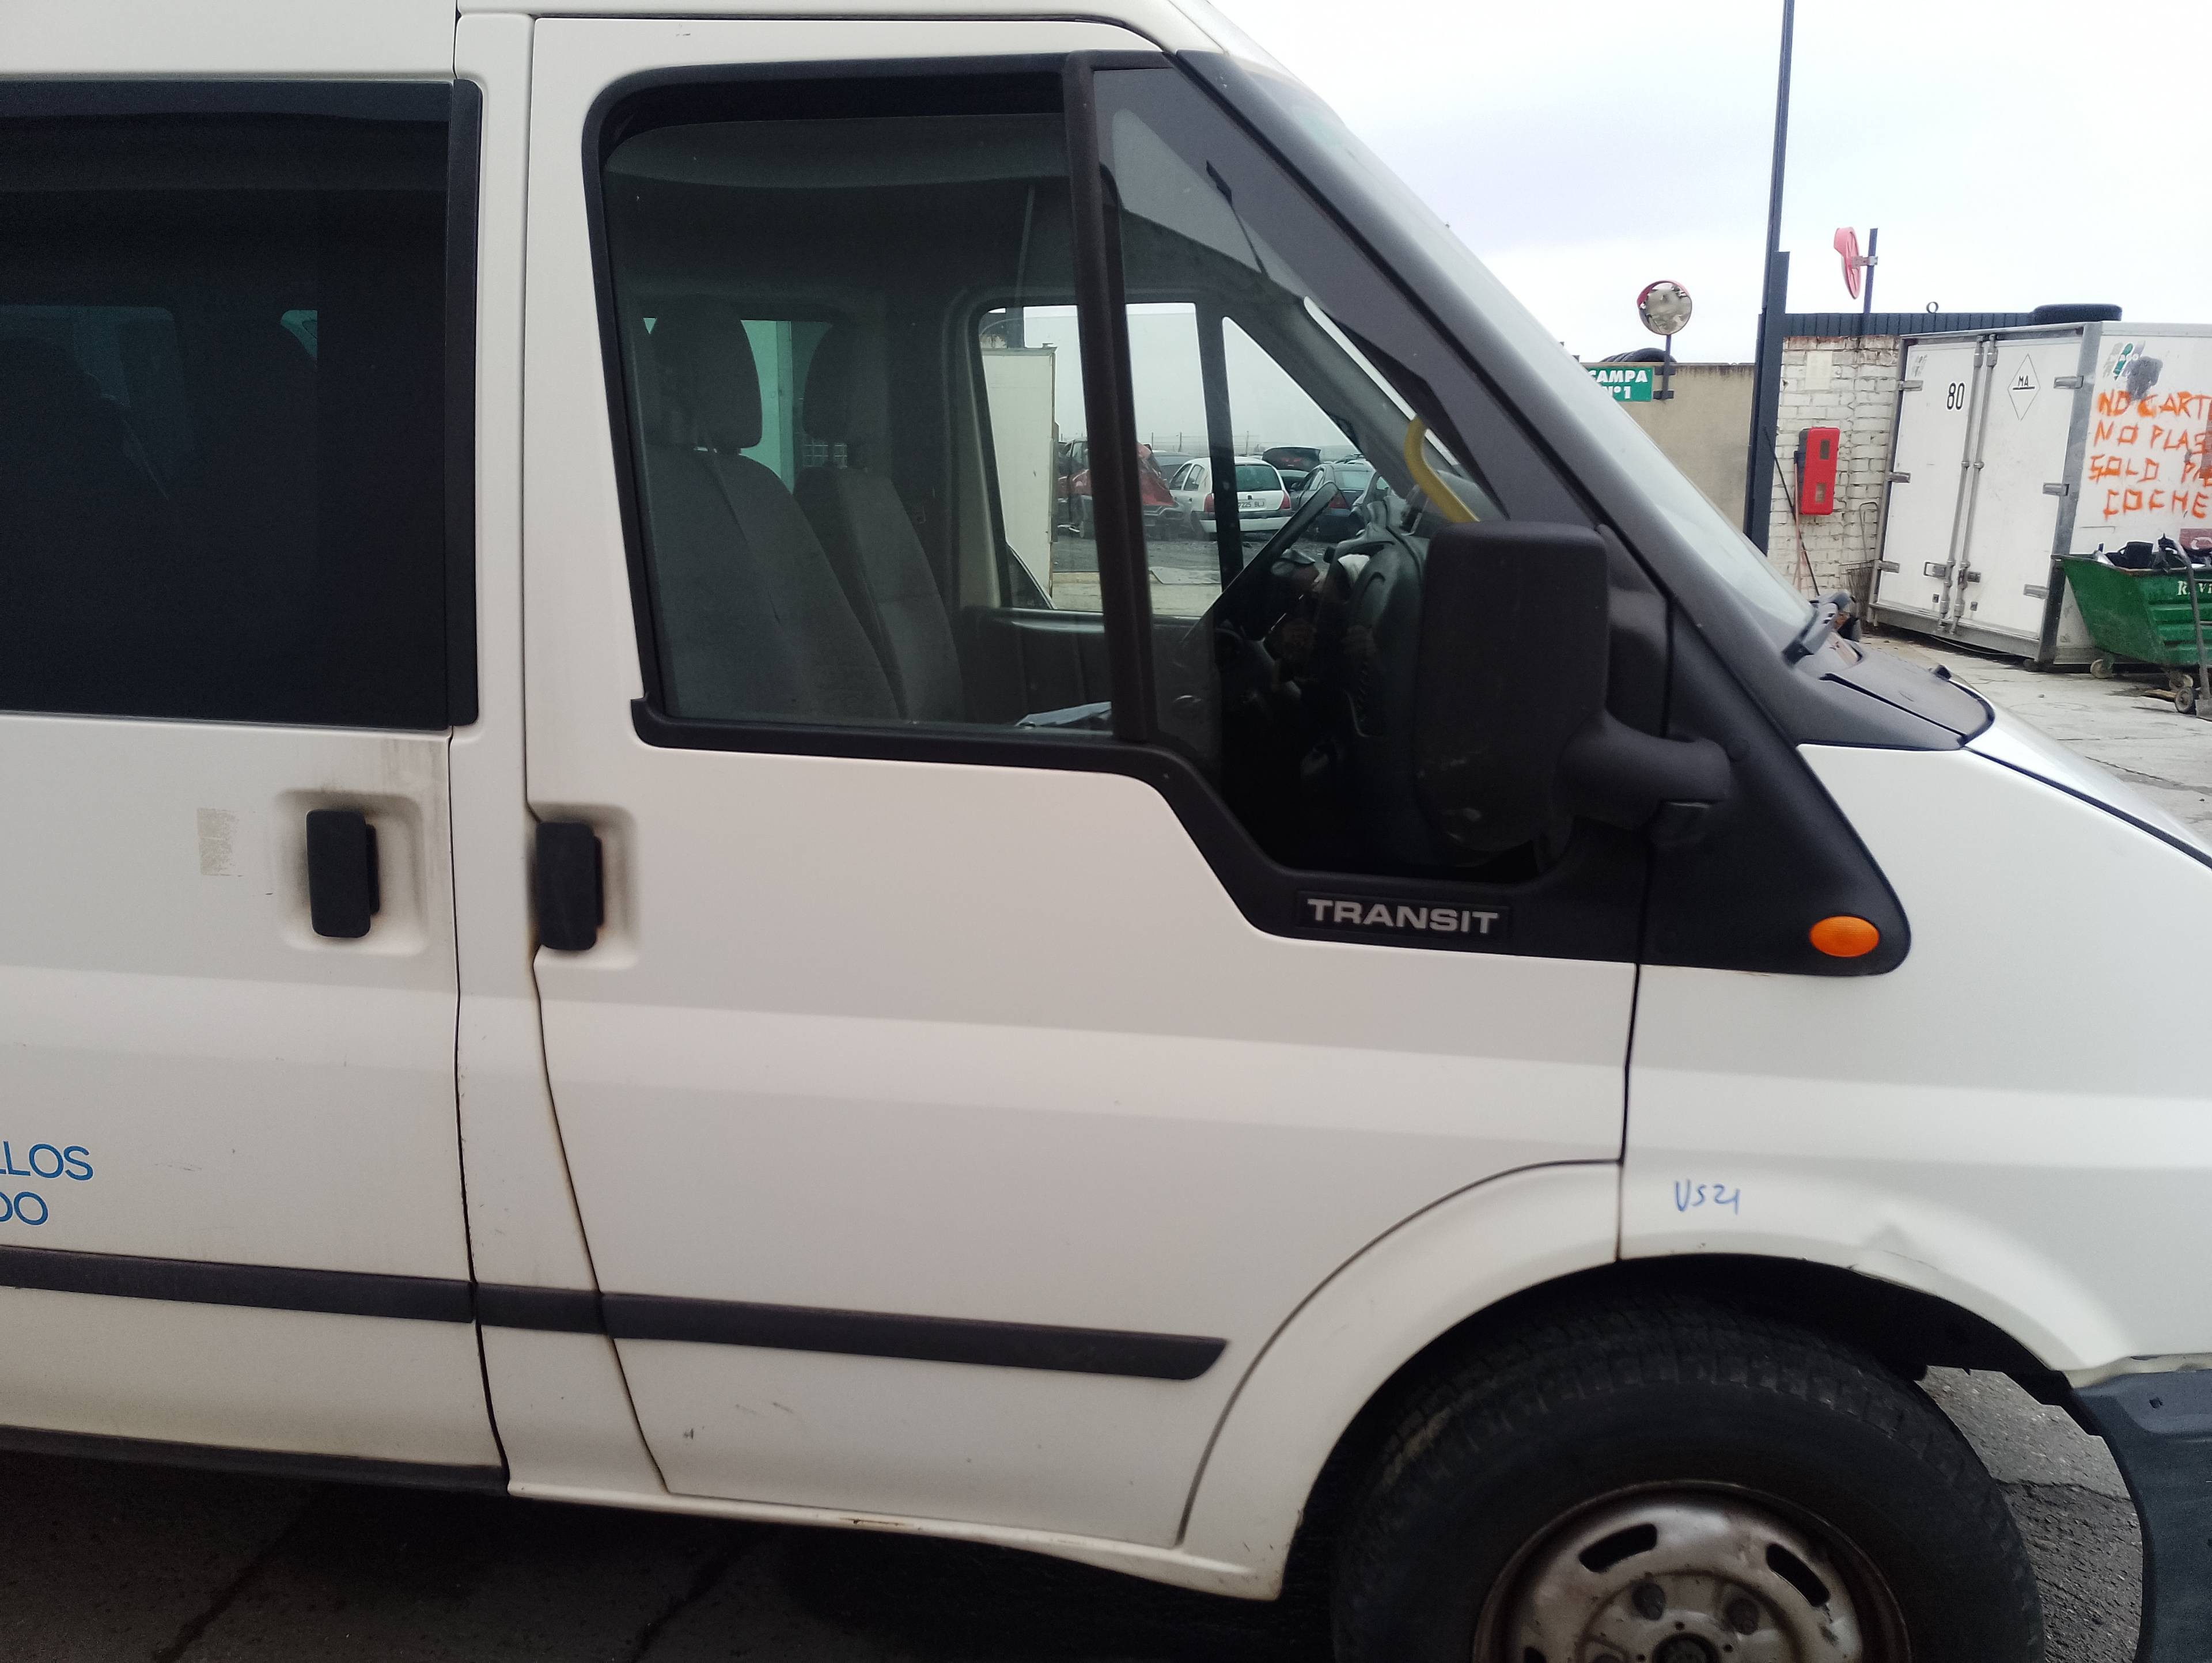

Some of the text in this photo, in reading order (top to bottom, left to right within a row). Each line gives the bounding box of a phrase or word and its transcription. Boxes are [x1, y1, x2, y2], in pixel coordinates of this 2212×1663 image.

[2018, 375, 2029, 387] MA
[1946, 382, 1965, 410] 80
[2137, 391, 2212, 420] CART
[2093, 420, 2138, 447] NO
[2103, 488, 2209, 521] COCHE
[1307, 899, 1498, 934] TRANSIT
[0, 1141, 93, 1180] LOS
